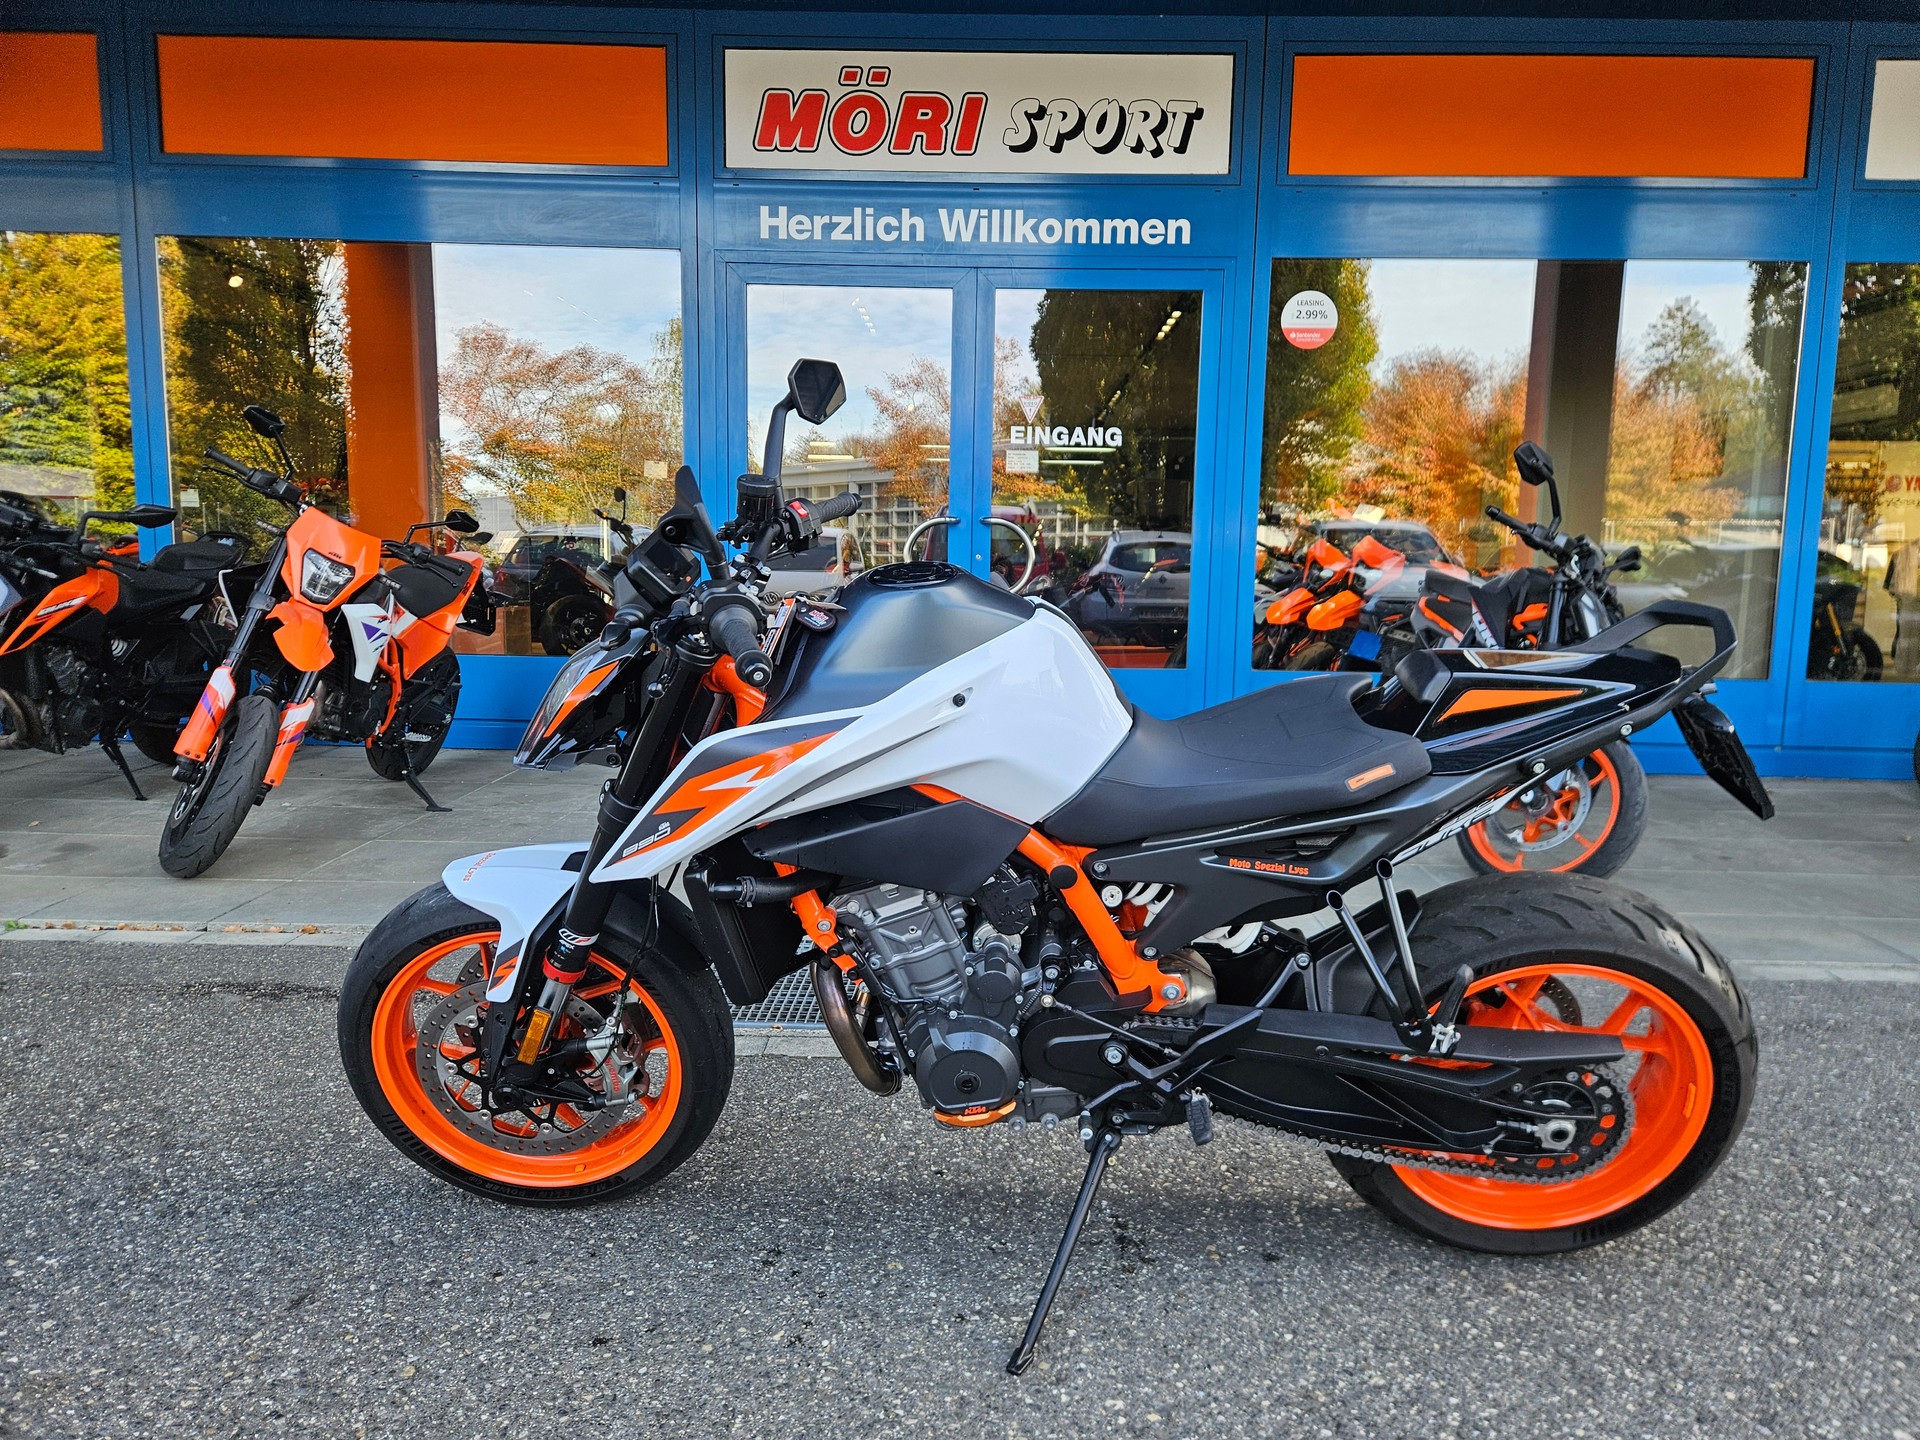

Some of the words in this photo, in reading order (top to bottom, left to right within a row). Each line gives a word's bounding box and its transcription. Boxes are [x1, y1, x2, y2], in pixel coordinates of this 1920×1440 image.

[753, 65, 988, 156] MÖRI
[1002, 97, 1204, 158] SPORT
[760, 205, 925, 242] Herzlich
[938, 208, 1191, 245] Willkommen
[1296, 309, 1328, 320] 2.99%
[1010, 425, 1123, 447] EINGANG
[622, 826, 671, 858] 890
[1229, 858, 1251, 869] Moto
[1254, 861, 1286, 873] Spezial
[1288, 864, 1309, 875] Lyss
[964, 1106, 986, 1115] KTM
